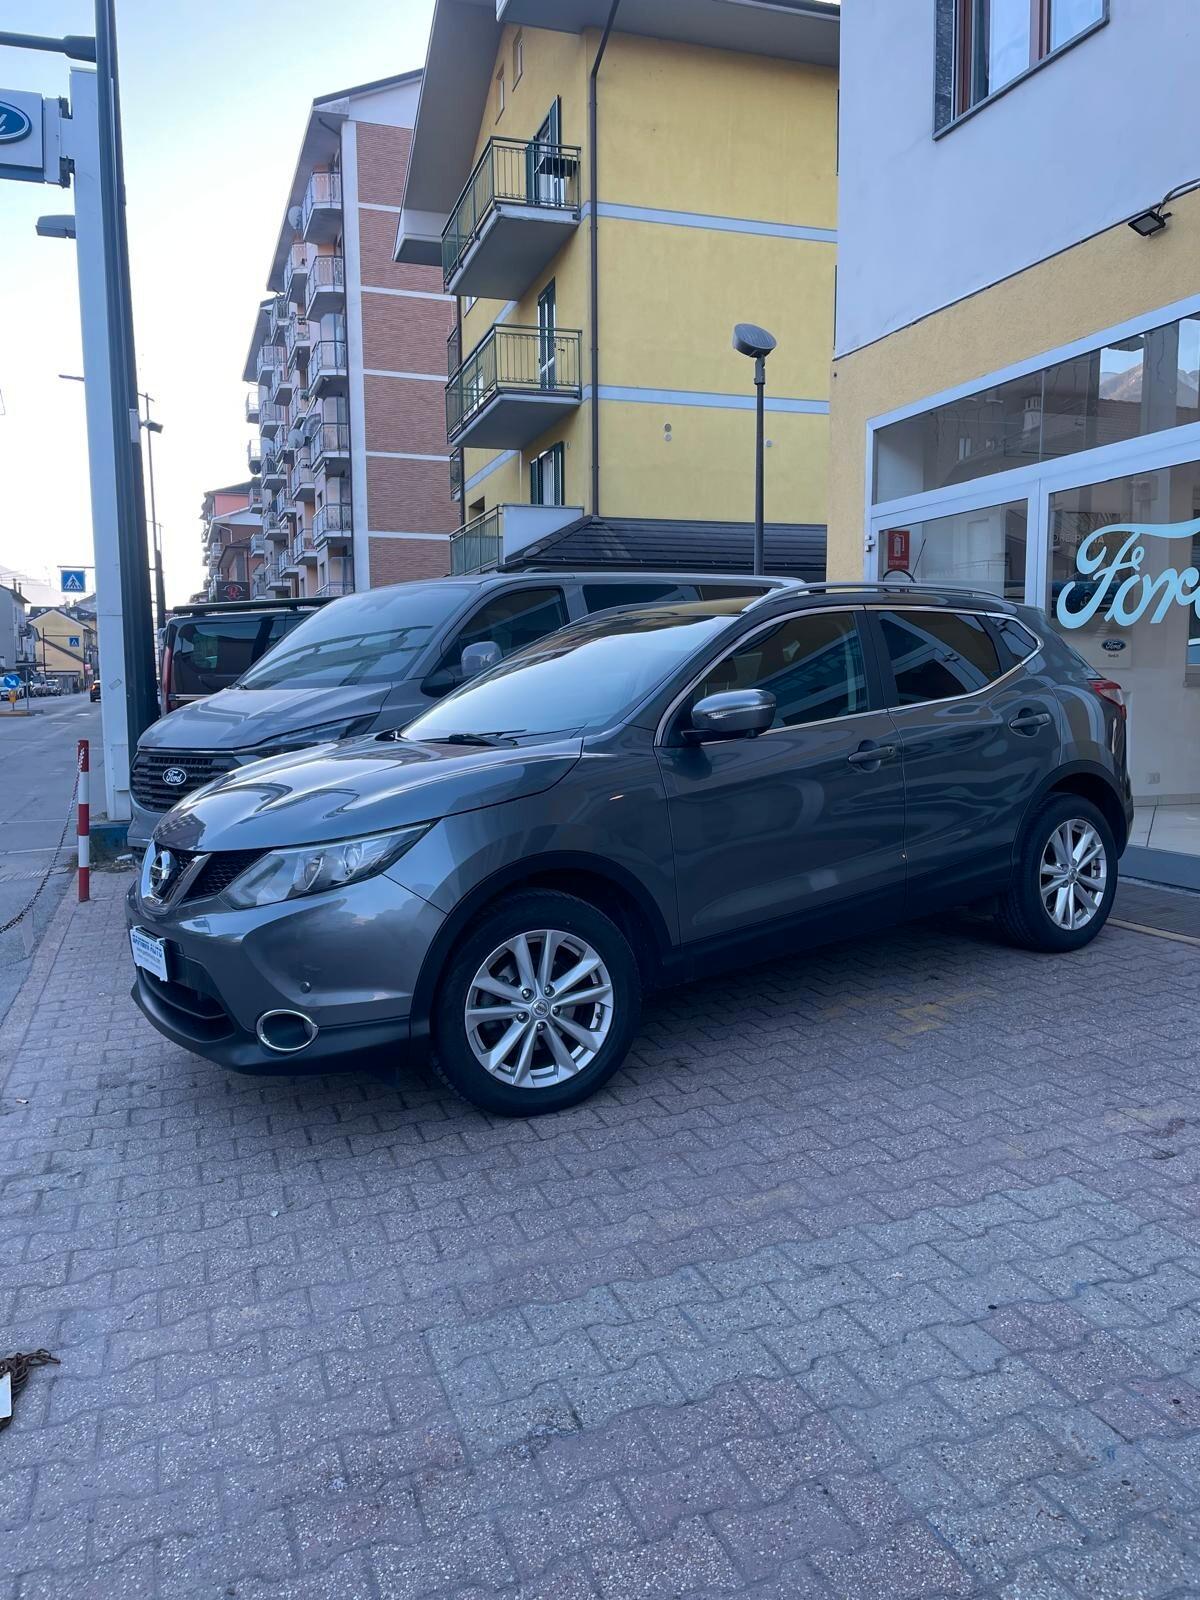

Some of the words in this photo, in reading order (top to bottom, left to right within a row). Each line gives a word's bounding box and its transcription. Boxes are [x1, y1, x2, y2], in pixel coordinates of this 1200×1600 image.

[1057, 517, 1200, 629] For
[1105, 640, 1122, 649] Ford
[166, 770, 183, 782] Ford
